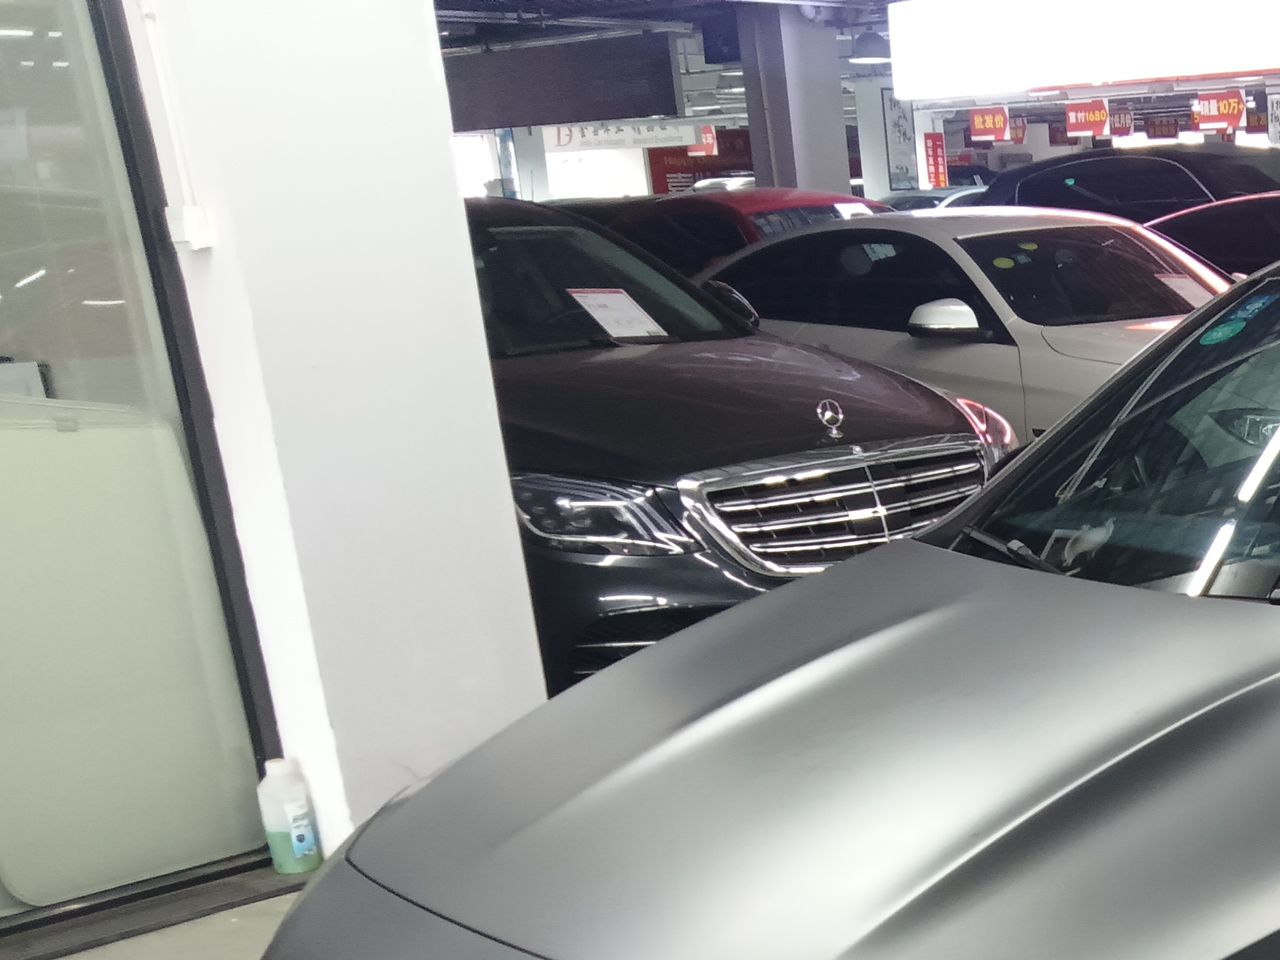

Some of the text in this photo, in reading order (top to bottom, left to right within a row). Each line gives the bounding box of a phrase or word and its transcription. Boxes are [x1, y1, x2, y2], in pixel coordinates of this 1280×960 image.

[973, 113, 1005, 130] 批发价
[1068, 110, 1108, 124] 首付1680
